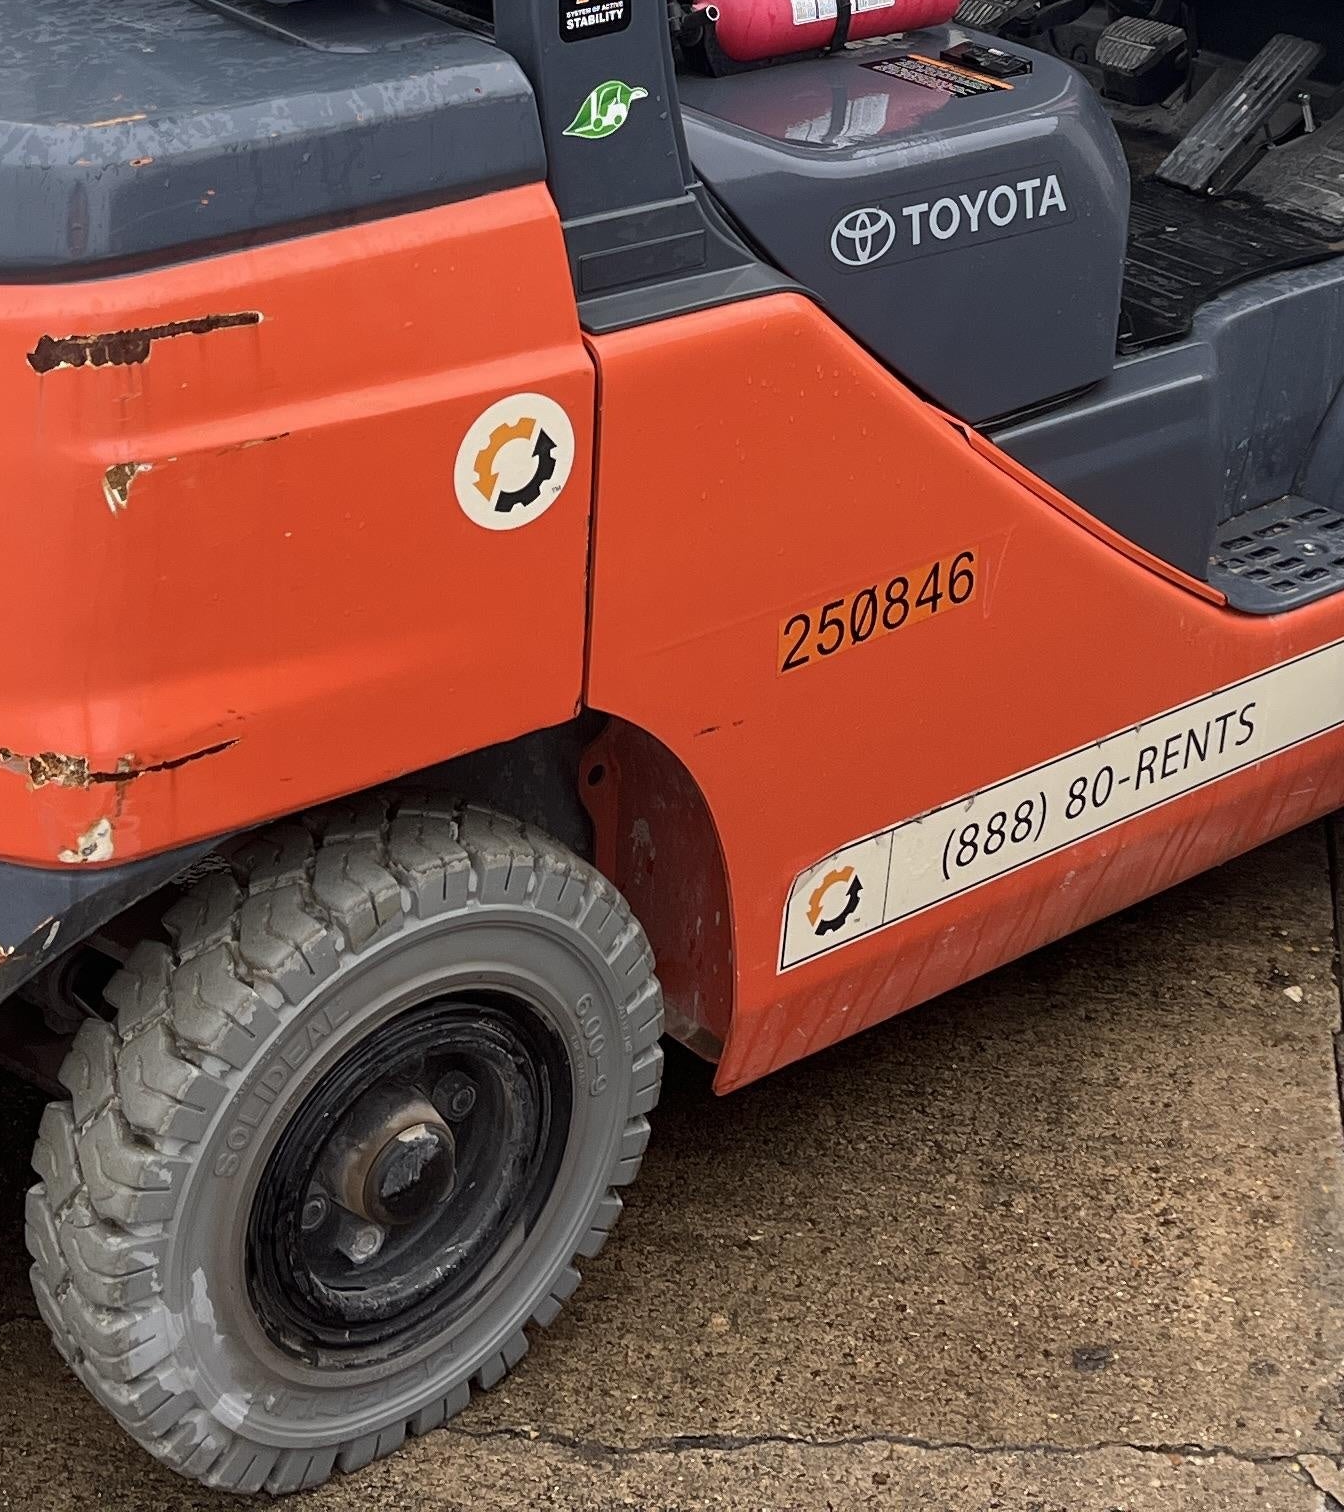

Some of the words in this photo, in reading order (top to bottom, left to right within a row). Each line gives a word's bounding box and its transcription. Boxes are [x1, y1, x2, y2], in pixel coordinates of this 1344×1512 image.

[566, 7, 592, 19] SYSTEM
[592, 5, 601, 13] OF
[601, 0, 624, 11] ACTIVE
[566, 8, 624, 30] STABILITY
[902, 174, 1067, 246] TOYOTA
[780, 550, 976, 673] 250846
[941, 791, 1049, 881] (888)
[1064, 702, 1257, 820] 80-RENTS
[212, 1008, 353, 1178] SOLIDEAL
[575, 992, 609, 1097] 6.00-9
